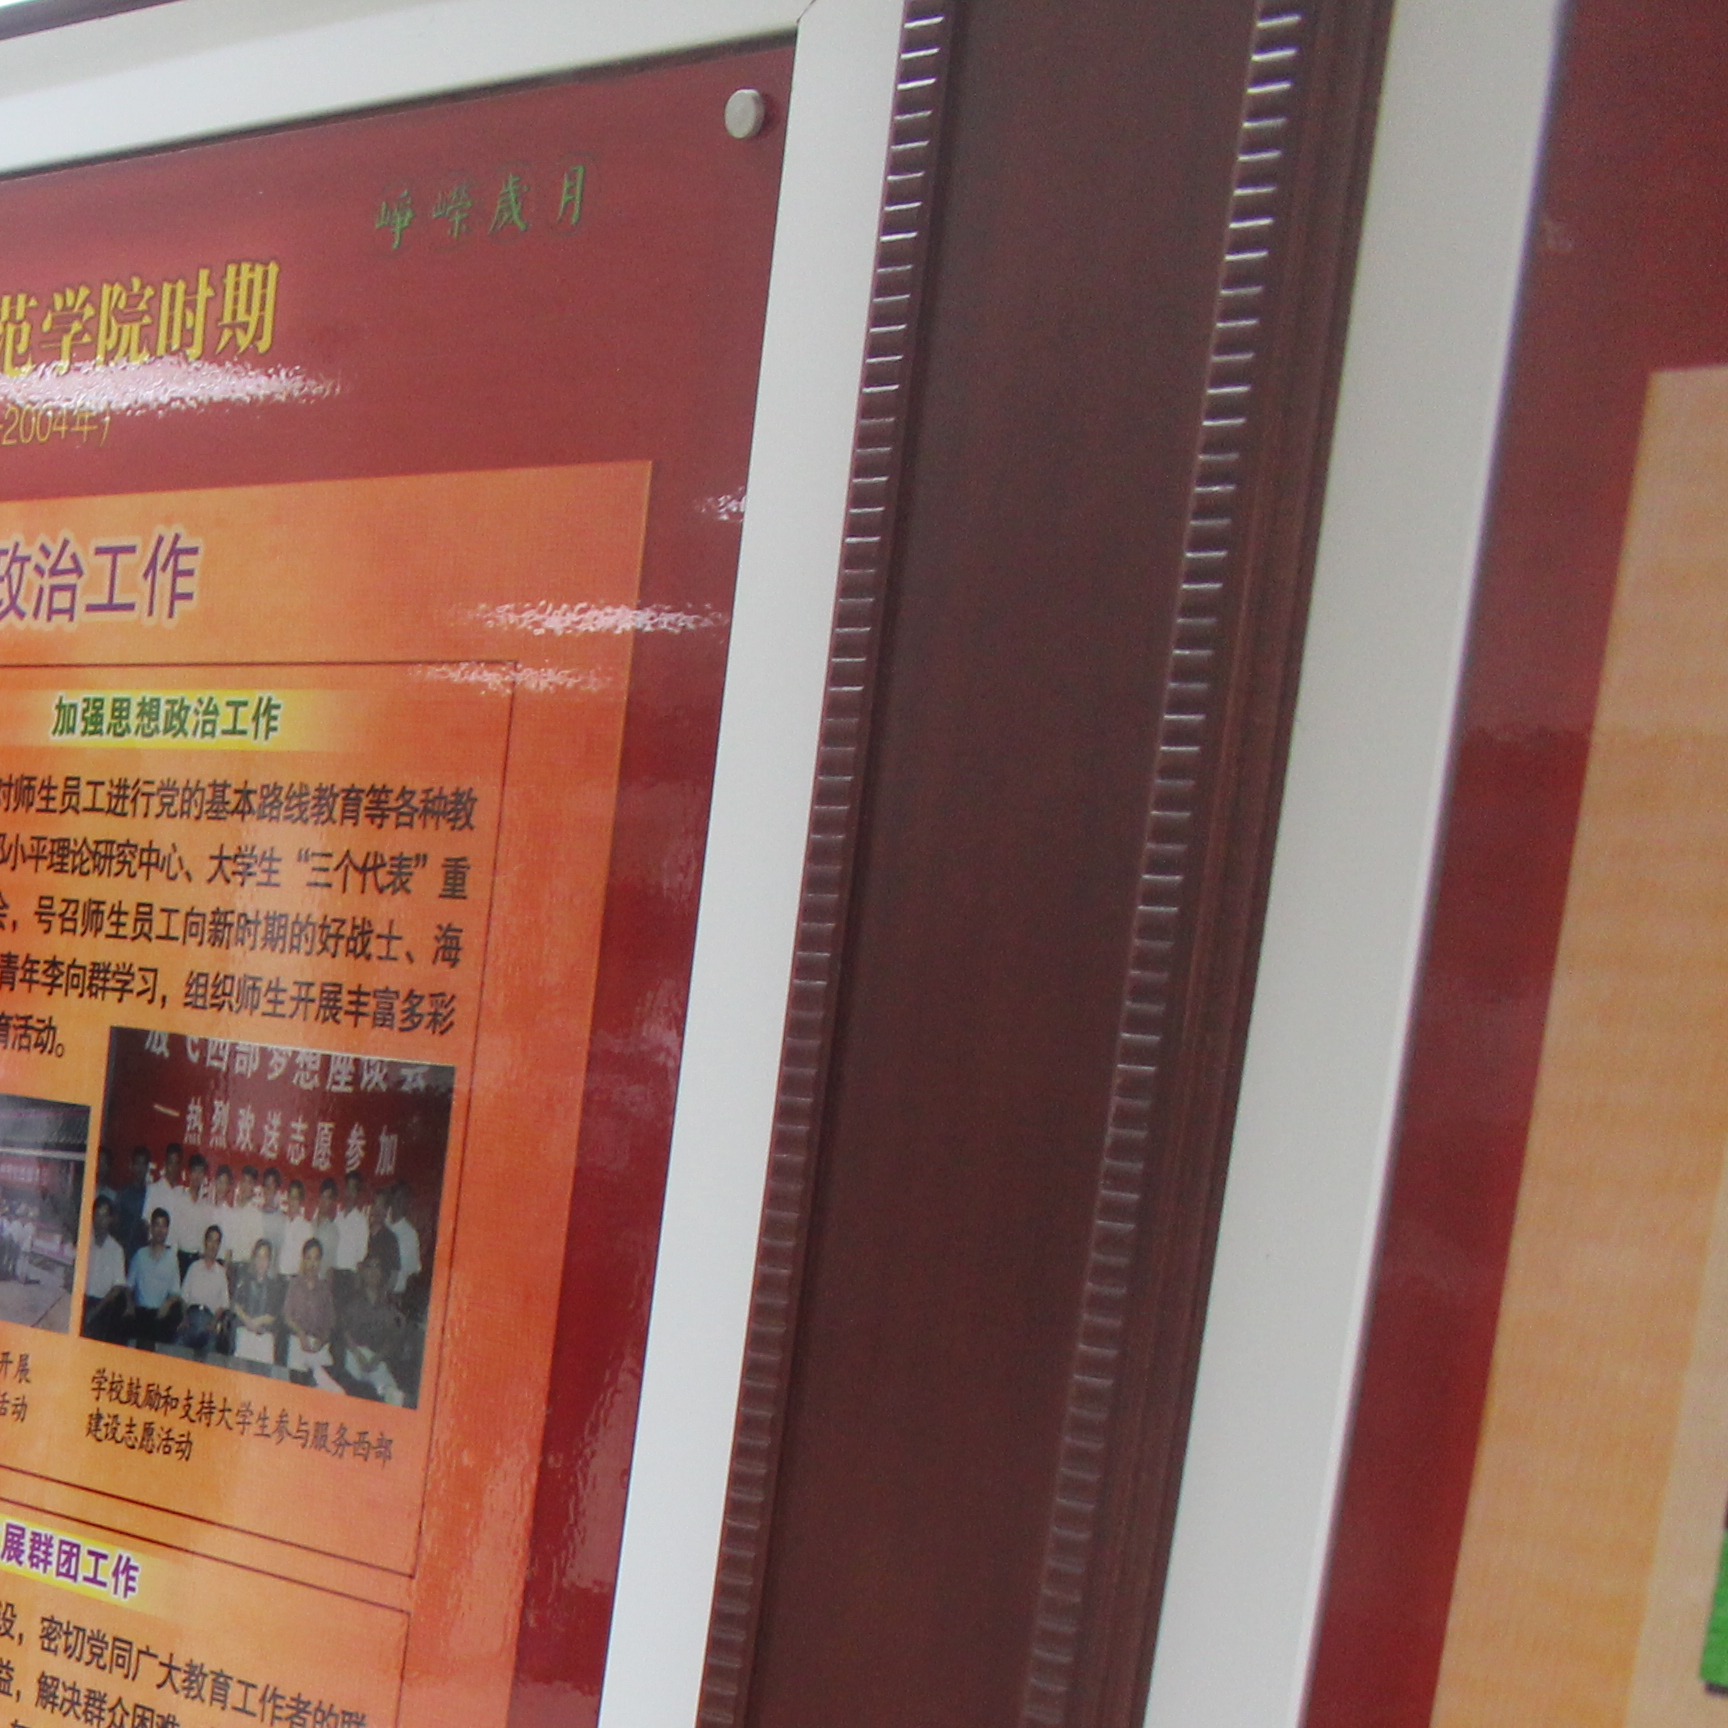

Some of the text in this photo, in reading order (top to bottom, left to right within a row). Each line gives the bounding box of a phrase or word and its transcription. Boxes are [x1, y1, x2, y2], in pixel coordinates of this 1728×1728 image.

[50, 693, 283, 741] 加强思想政治工作
[85, 1411, 194, 1462] 建设志愿活动
